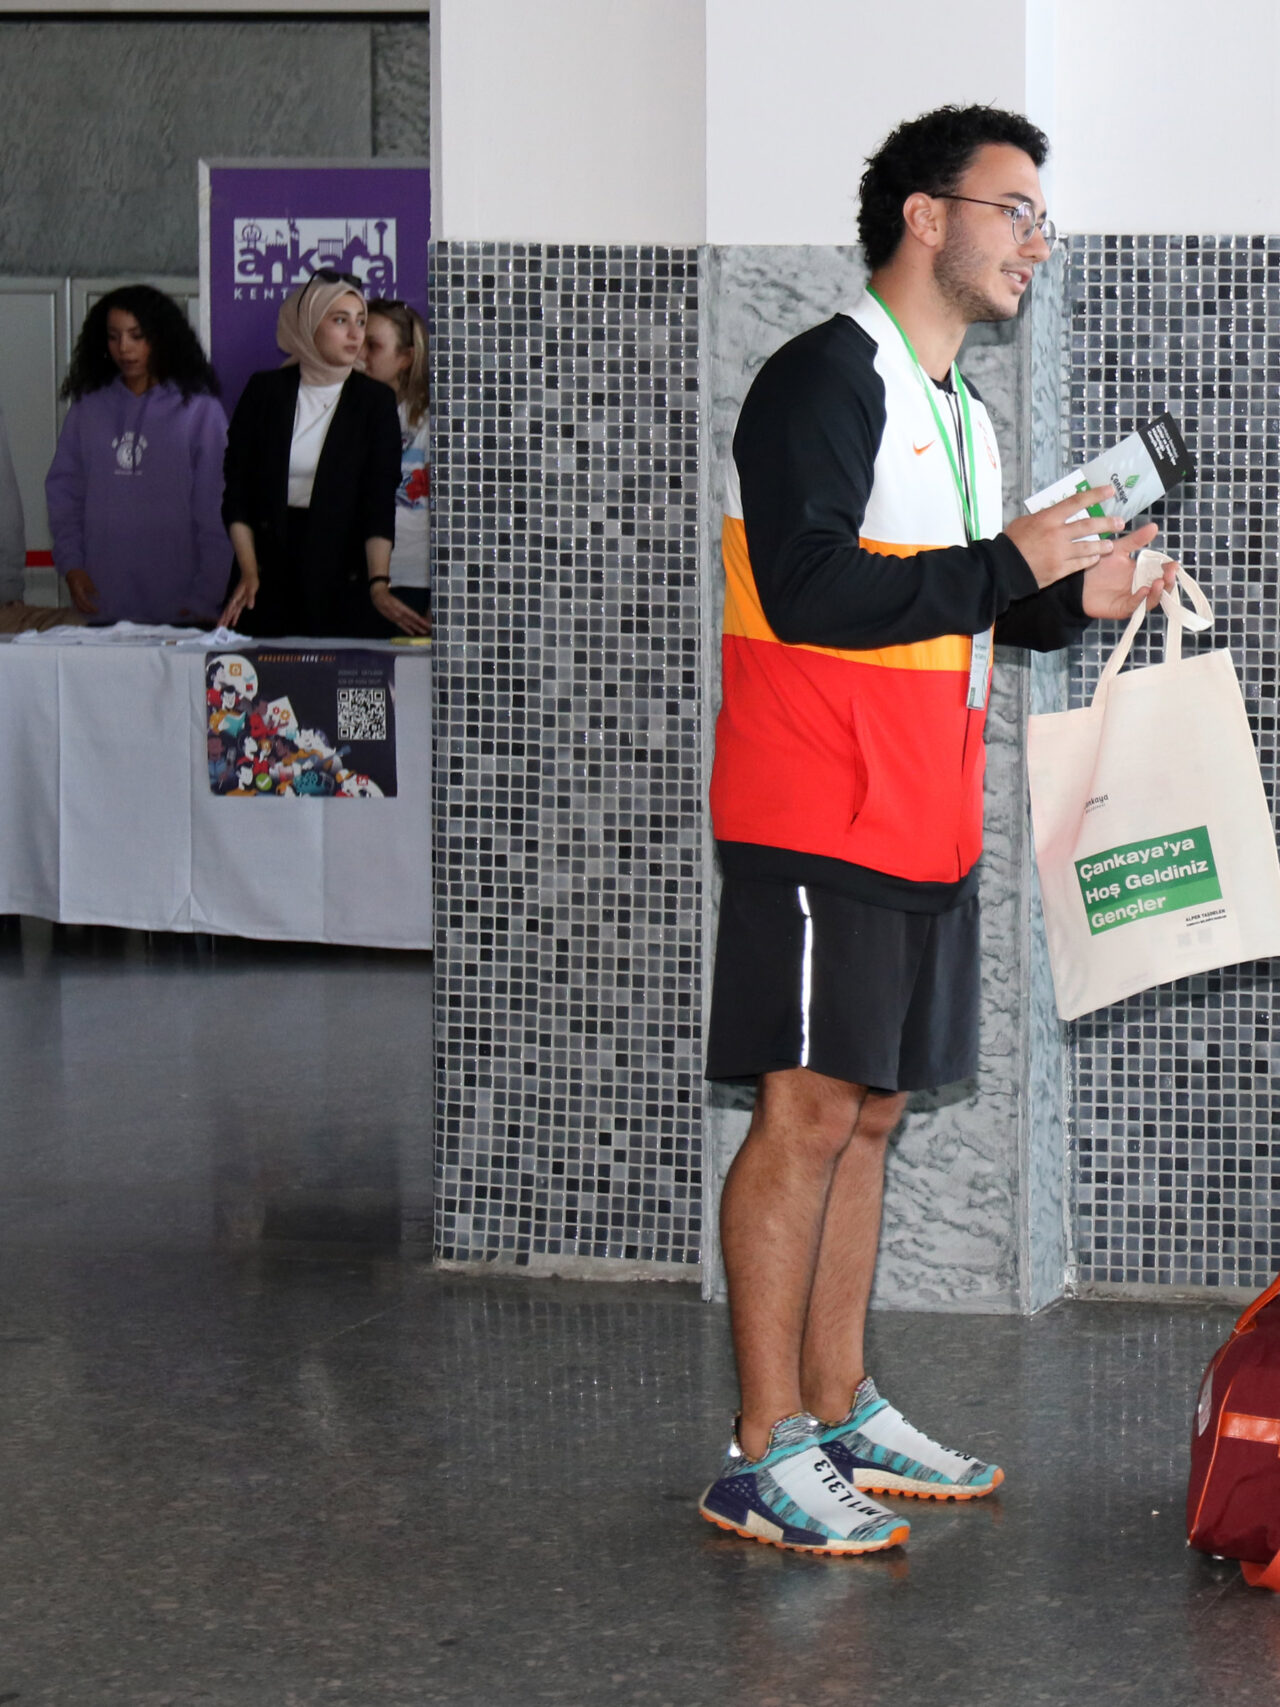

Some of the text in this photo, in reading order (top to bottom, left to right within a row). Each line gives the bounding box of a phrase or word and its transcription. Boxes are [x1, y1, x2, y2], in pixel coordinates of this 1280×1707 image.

[233, 287, 288, 300] KENT
[1079, 838, 1196, 882] Çankaya'ya
[1085, 860, 1209, 904] Hoş Geldiniz
[1091, 896, 1167, 929] Gençler
